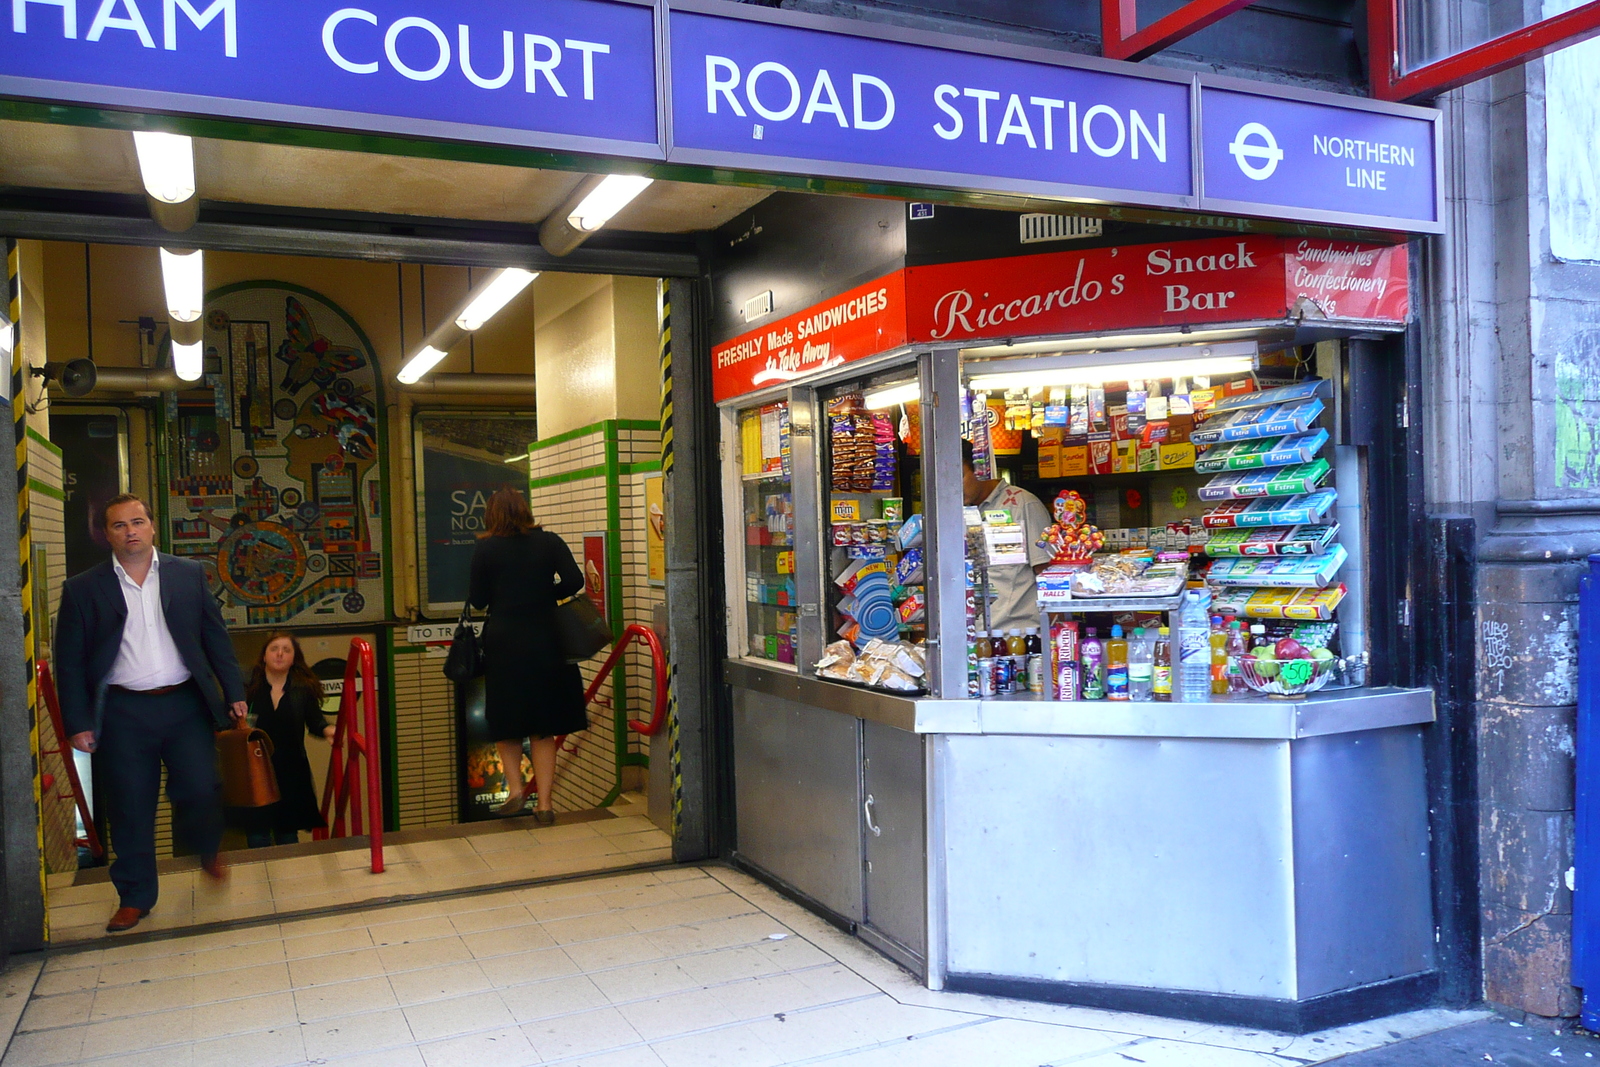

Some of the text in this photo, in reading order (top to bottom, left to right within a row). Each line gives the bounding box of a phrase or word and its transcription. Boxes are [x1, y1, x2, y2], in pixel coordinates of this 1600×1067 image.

[13, 0, 610, 101] HAM COURT
[706, 54, 1167, 163] ROAD STATION
[1313, 134, 1415, 167] NORTHERN
[1346, 166, 1387, 191] LINE
[1146, 242, 1257, 276] Snack
[1295, 240, 1374, 266] Sandwiches
[930, 247, 1125, 339] Riccardo's
[1294, 266, 1387, 300] Confectionery
[1163, 283, 1236, 312] Bar
[717, 288, 887, 369] FRESHLY Made SANDWICHES
[766, 340, 830, 372] to Take Away
[1200, 433, 1217, 441] Extra
[1231, 429, 1249, 437] Extra
[1265, 424, 1287, 432] Extra
[1271, 453, 1292, 462] Extra
[1205, 488, 1224, 497] Extra
[1241, 486, 1258, 494] Extra
[1274, 483, 1296, 491] Extra
[1209, 517, 1229, 525] Extra
[1242, 514, 1264, 523] Extra
[865, 563, 880, 572] NEW
[1043, 590, 1066, 598] HALLS
[415, 626, 433, 638] TO
[1059, 627, 1071, 661] Ribena
[1289, 663, 1309, 681] 50
[1061, 667, 1073, 700] Ribena
